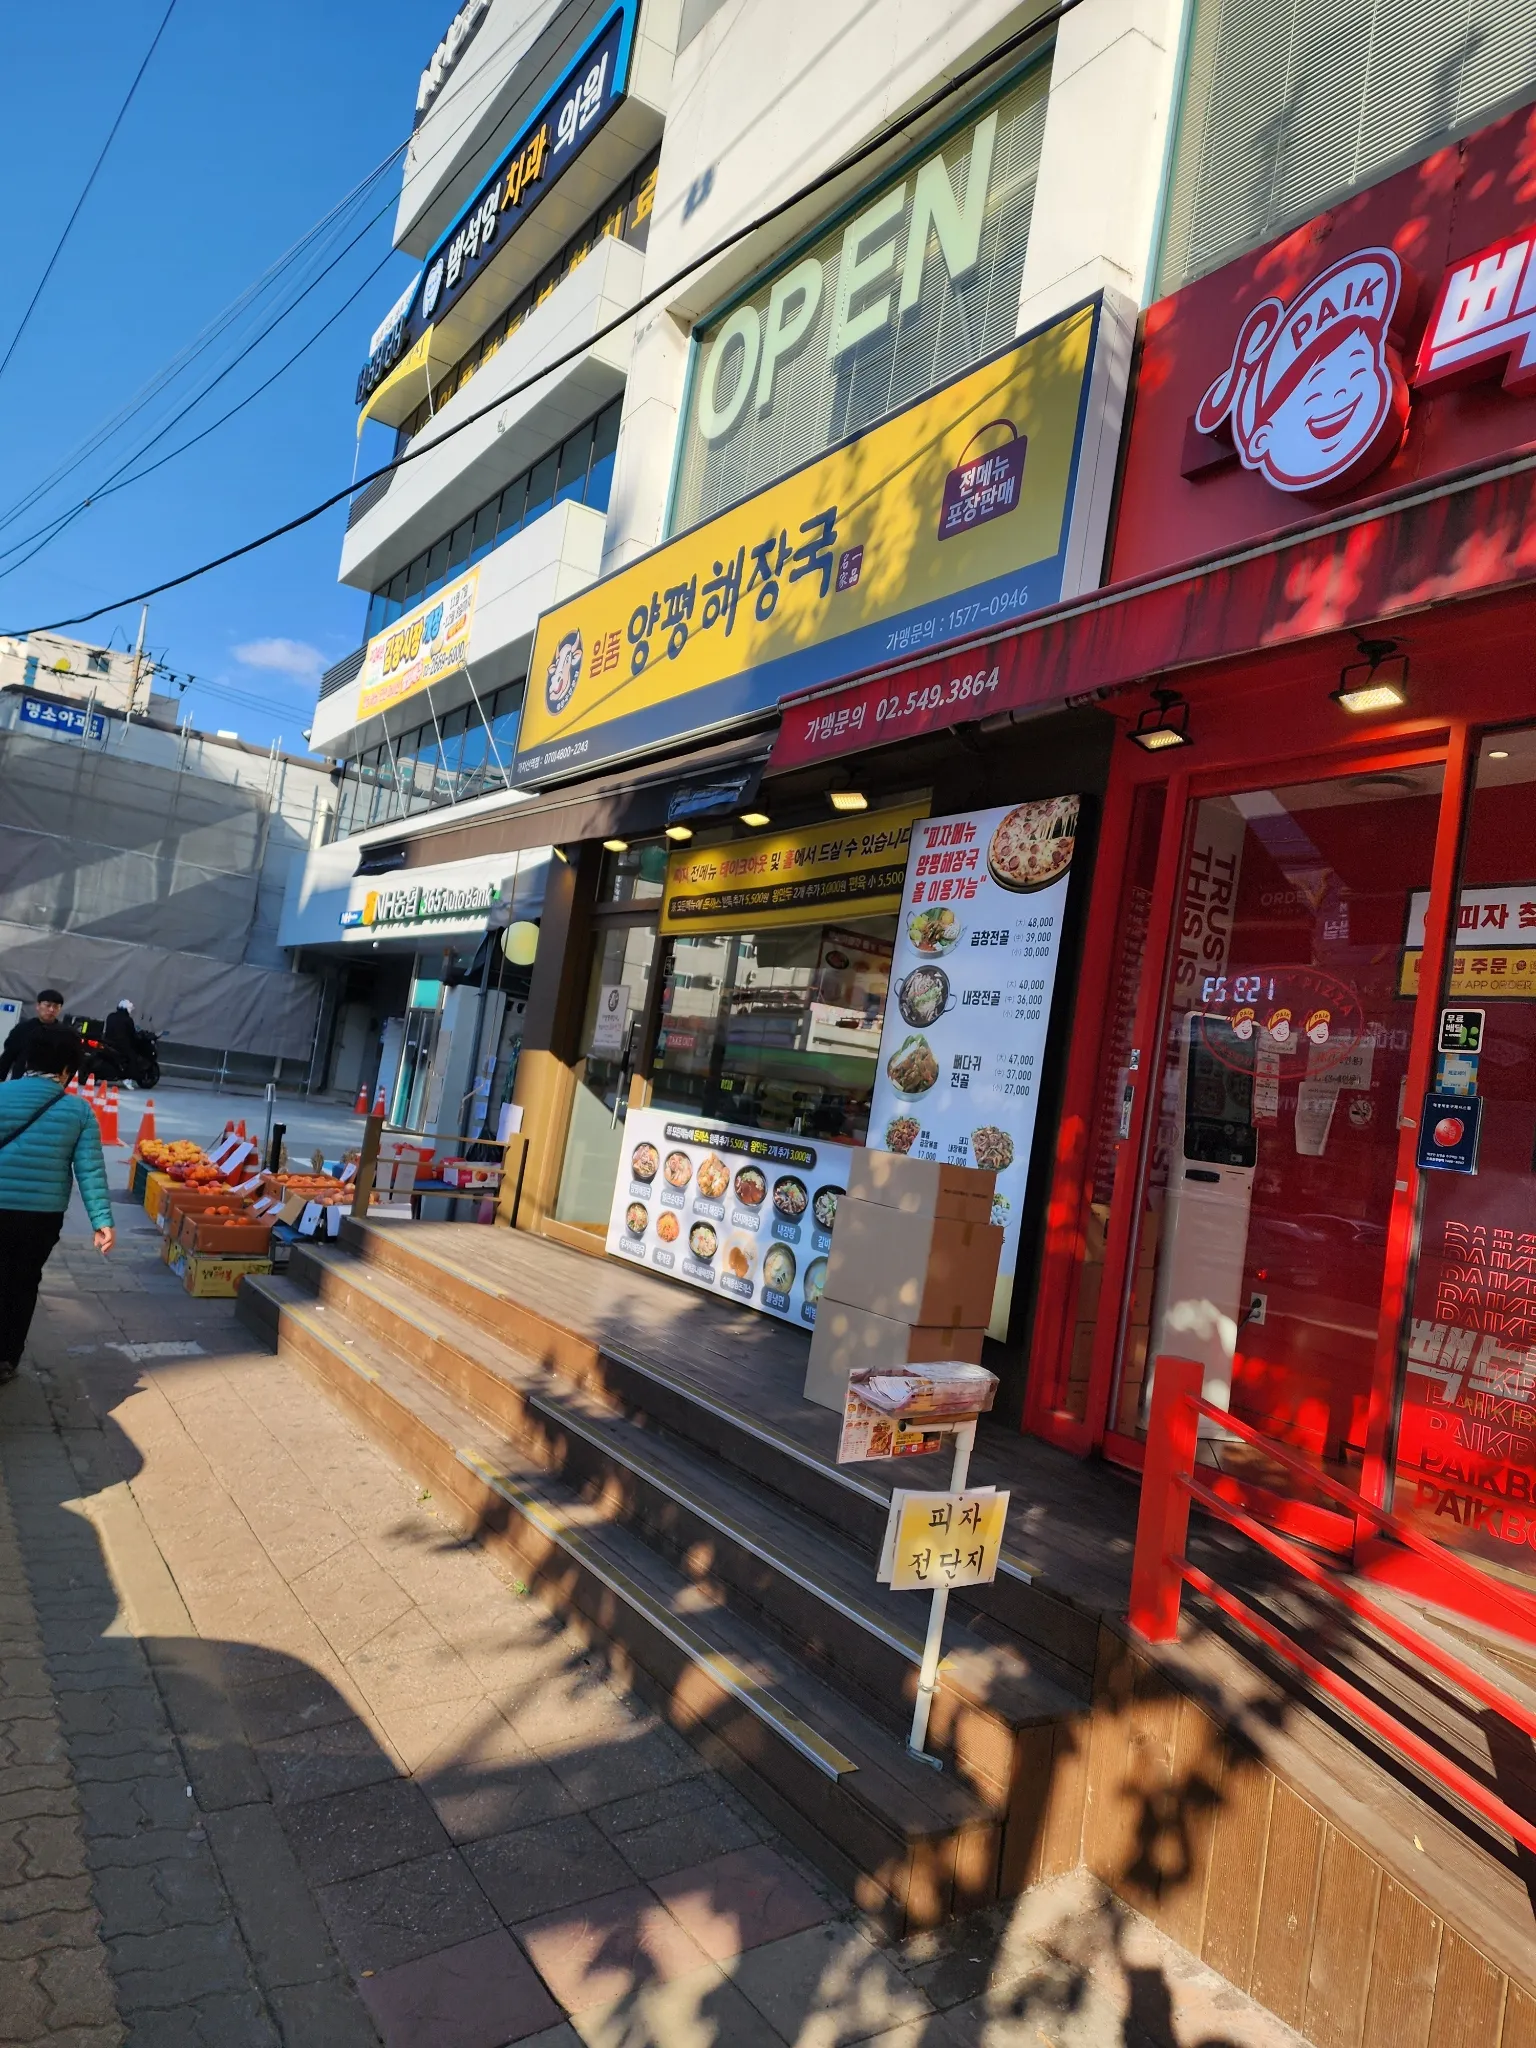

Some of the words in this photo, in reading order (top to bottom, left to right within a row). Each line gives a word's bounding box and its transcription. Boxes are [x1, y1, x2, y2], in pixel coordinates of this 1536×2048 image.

[501, 124, 549, 210] 치과
[553, 51, 608, 155] 의원
[699, 110, 998, 440] OPEN
[1290, 277, 1384, 350] PAIK
[959, 456, 1009, 497] 전메뉴
[946, 476, 1015, 528] 포장판매
[590, 629, 622, 678] 일품
[627, 505, 838, 675] 양평해장국
[886, 617, 936, 651] 가맹문의
[950, 586, 1028, 631] 1577-0946
[804, 702, 866, 743] 가맹문의
[875, 666, 999, 722] 02.549.3864
[690, 863, 717, 883] 전메뉴
[719, 853, 768, 878] 테이크아웃
[771, 852, 781, 871] 및
[782, 843, 817, 870] 홀에서
[817, 841, 843, 862] 드실
[844, 839, 858, 857] 수
[915, 848, 980, 876] 양평해장국
[806, 884, 820, 897] 추가
[912, 885, 923, 903] 홀
[1180, 846, 1214, 939] THIS
[375, 889, 418, 921] NH농협
[1197, 854, 1237, 977] TRUST
[1458, 903, 1509, 929] 피자
[1028, 917, 1053, 928] 48,000
[970, 930, 1010, 947] 곱창전골
[1026, 932, 1052, 943] 39,000
[1023, 947, 1049, 958] 30,000
[1471, 957, 1507, 975] 주문
[1019, 979, 1045, 990] 40,000
[1465, 980, 1489, 989] APP
[1490, 979, 1531, 990] ORDER
[962, 990, 1001, 1007] 내장전골
[1017, 995, 1043, 1006] 36,000
[1015, 1009, 1041, 1020] 29,000
[1008, 1054, 1034, 1066] 47,000
[950, 1073, 970, 1089] 전골
[1006, 1069, 1032, 1081] 37,000
[1004, 1084, 1030, 1096] 27,000
[777, 1224, 796, 1239] 내장탕
[817, 1235, 831, 1249] 갈비
[928, 1502, 982, 1536] 피자
[908, 1545, 985, 1580] 전단지
